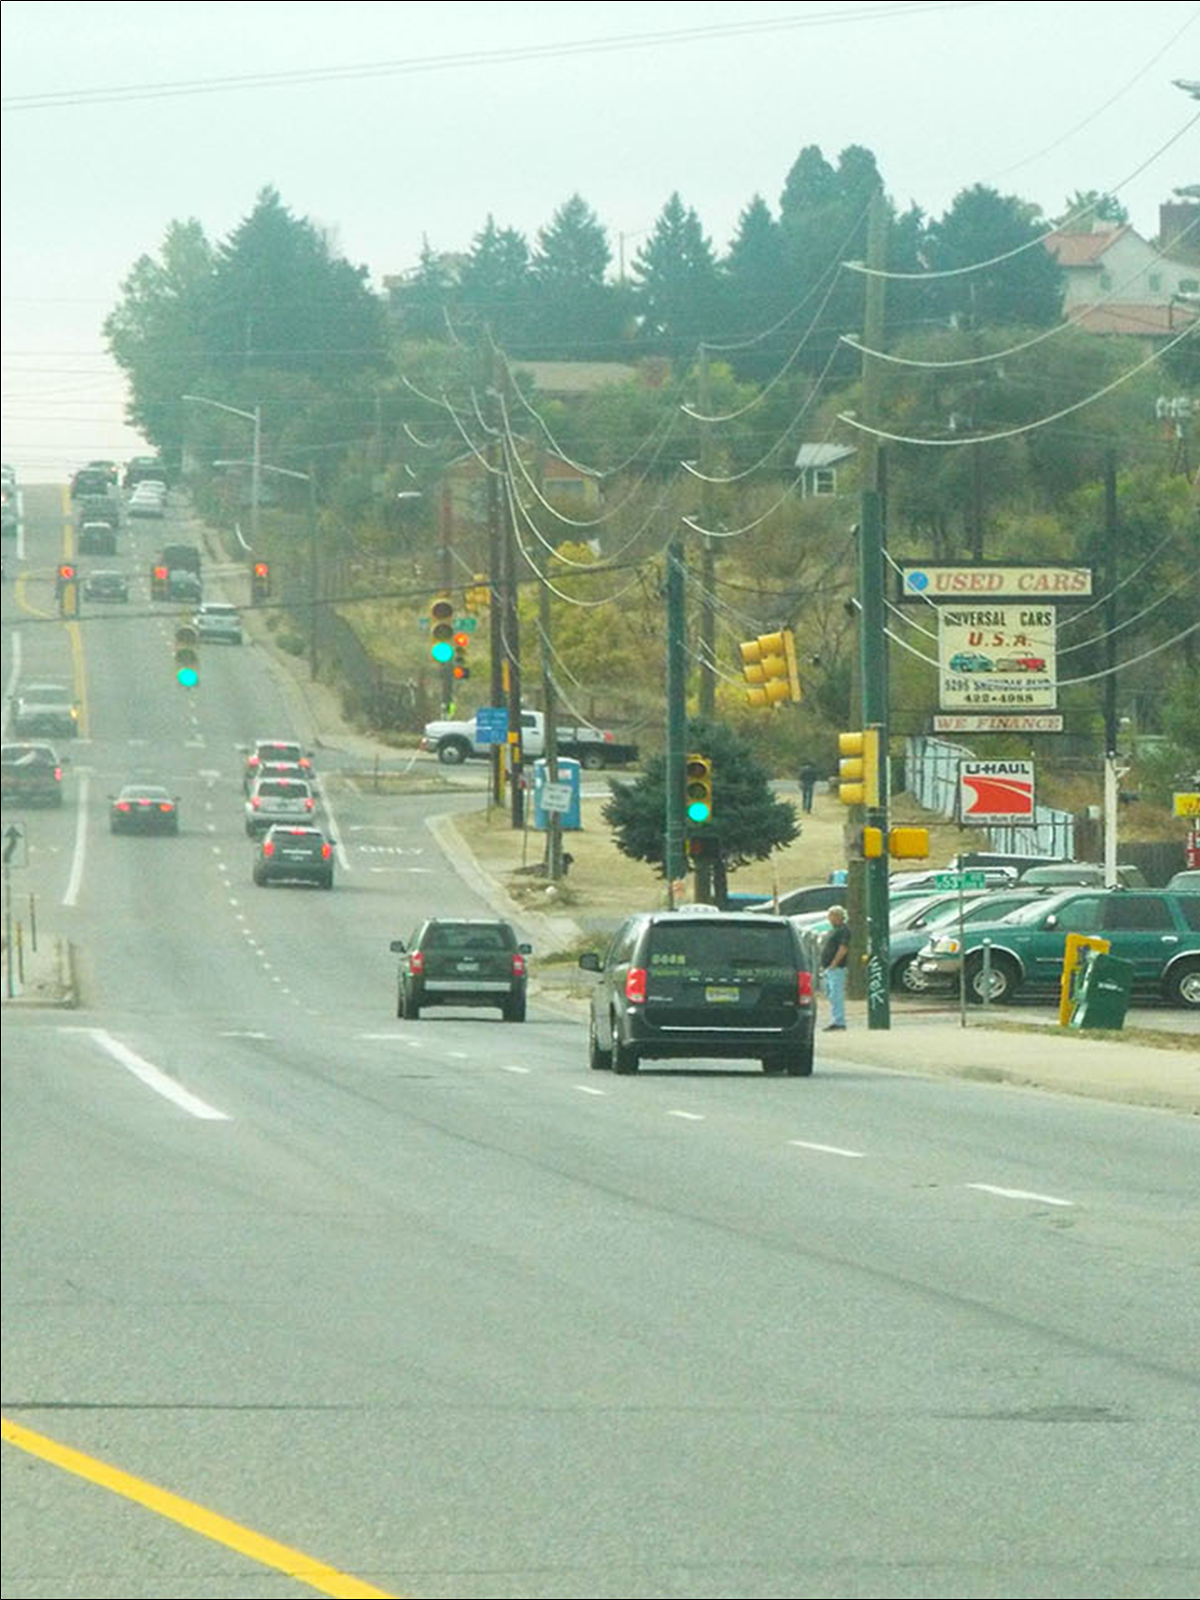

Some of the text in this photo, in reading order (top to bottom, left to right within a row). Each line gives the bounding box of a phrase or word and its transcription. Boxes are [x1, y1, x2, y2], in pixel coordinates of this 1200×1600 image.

[935, 573, 1086, 591] USED CARS
[1020, 612, 1052, 627] CARS
[968, 632, 1032, 647] U.S.A.
[937, 718, 1060, 729] WE FINANCE
[965, 763, 1030, 774] U-HAUL
